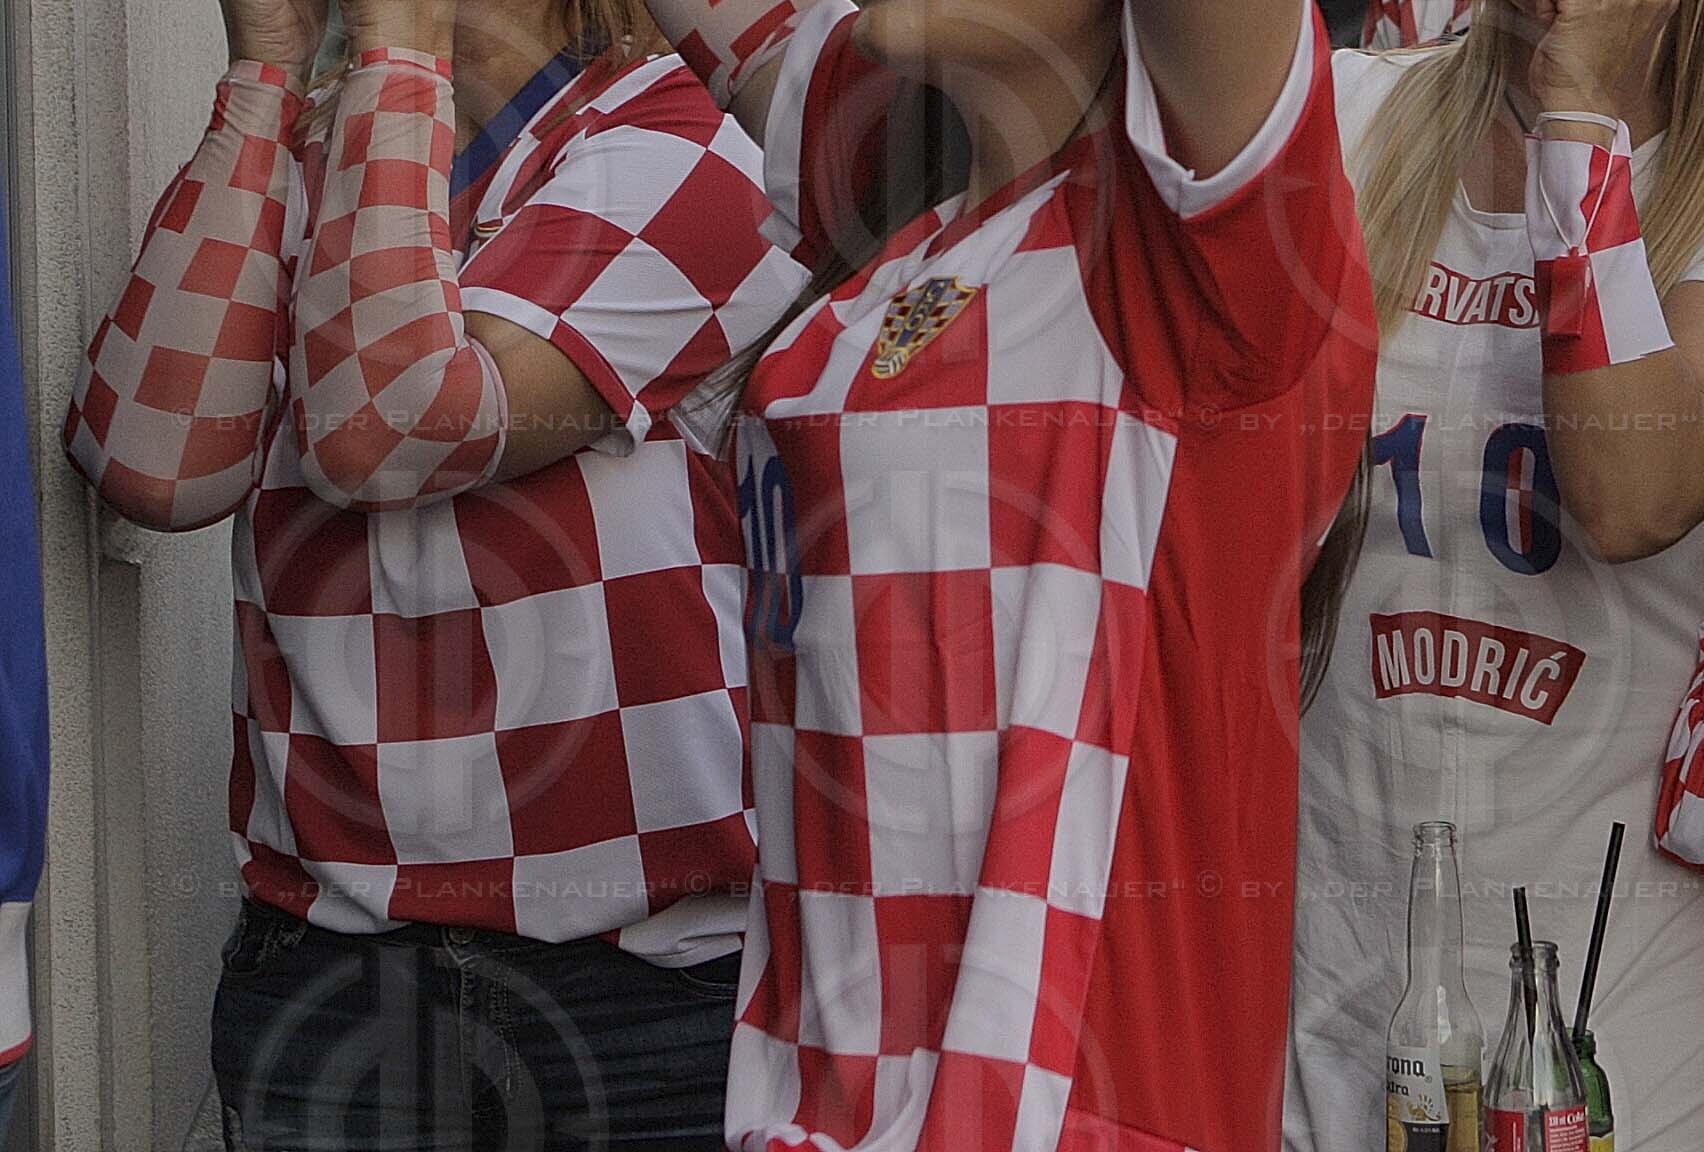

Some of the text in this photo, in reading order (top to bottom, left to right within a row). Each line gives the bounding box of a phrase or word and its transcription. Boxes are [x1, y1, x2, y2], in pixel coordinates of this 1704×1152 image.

[1414, 264, 1540, 327] RVATS
[1372, 413, 1562, 575] 10
[1376, 627, 1568, 710] MODRIĆ
